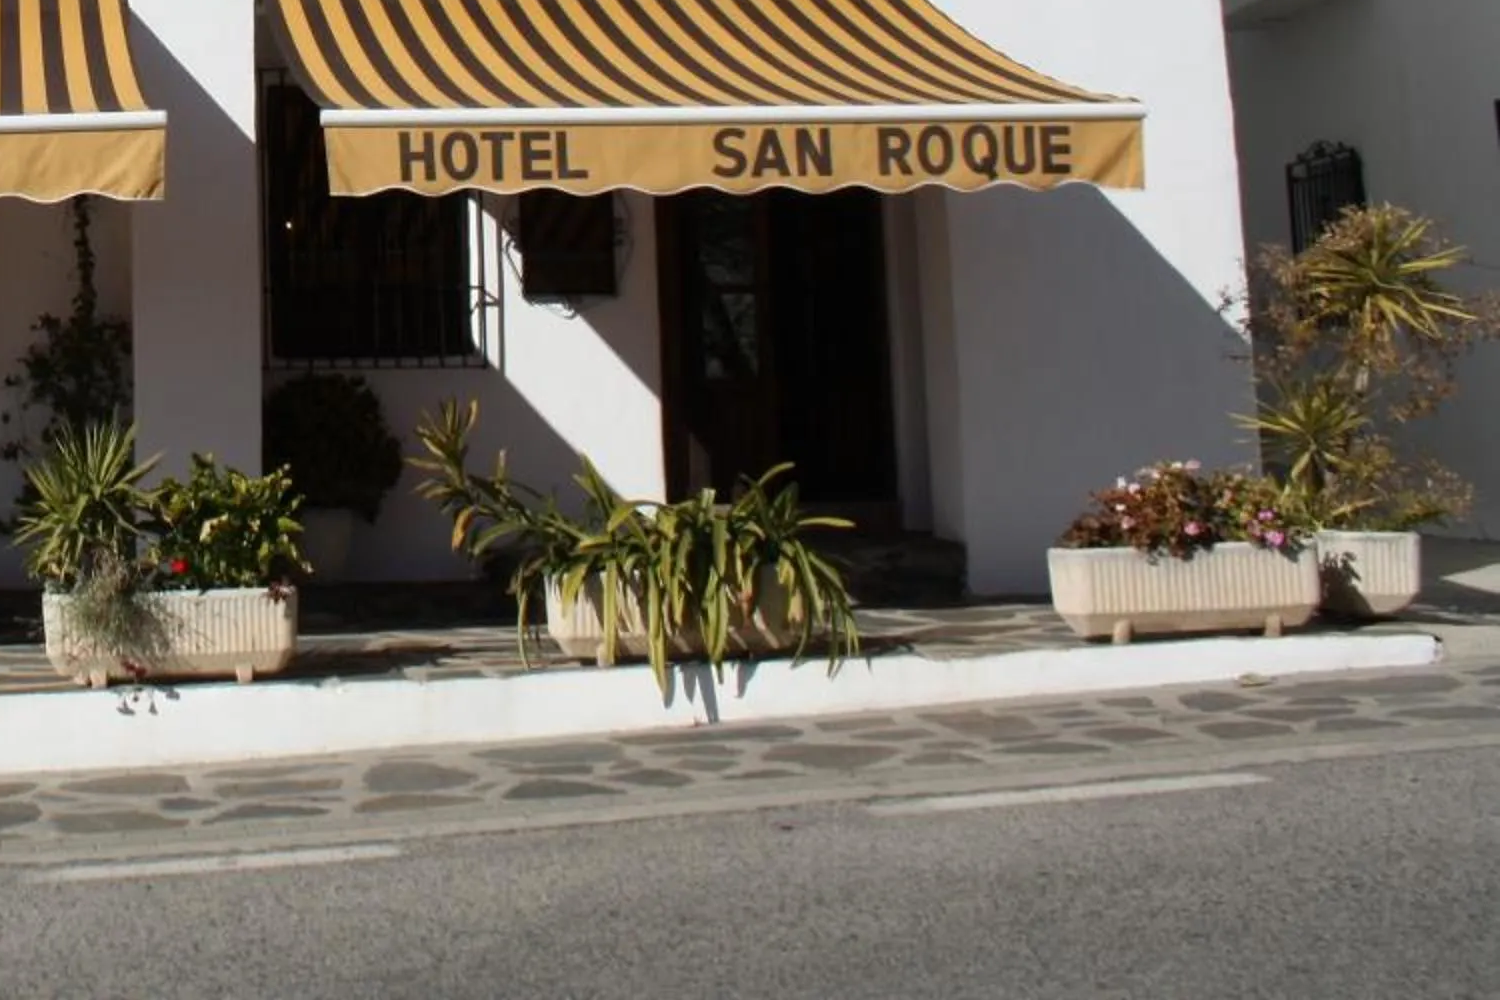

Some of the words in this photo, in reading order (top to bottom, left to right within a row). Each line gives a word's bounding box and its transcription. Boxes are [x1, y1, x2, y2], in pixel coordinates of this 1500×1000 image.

[397, 130, 589, 182] HOTEL
[711, 126, 833, 179] SAN
[876, 123, 1072, 181] ROQUE
